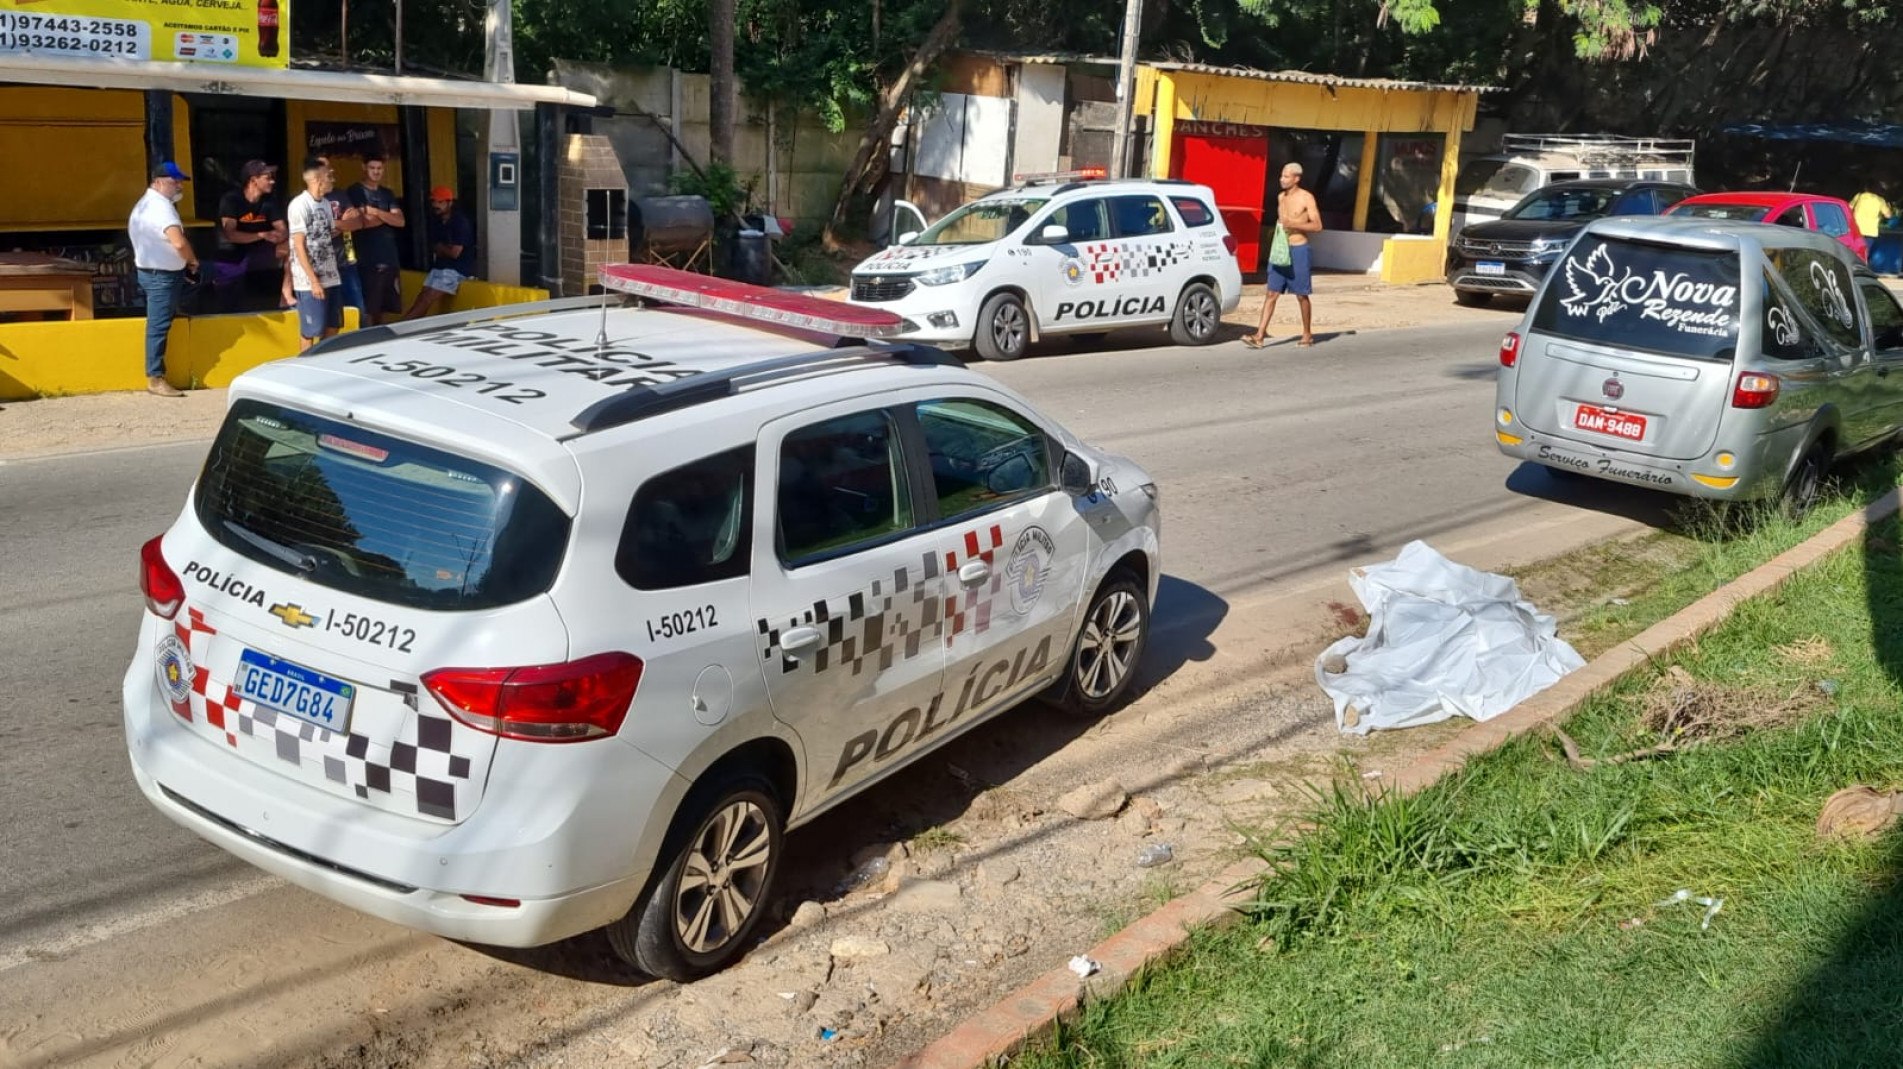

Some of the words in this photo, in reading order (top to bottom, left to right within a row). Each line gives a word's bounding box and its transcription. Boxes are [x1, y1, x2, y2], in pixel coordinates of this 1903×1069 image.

[1054, 294, 1166, 321] POLÍCIA
[1621, 270, 1736, 307] Nova
[1640, 298, 1730, 327] Rezende
[349, 353, 547, 404] I-50212
[1538, 446, 1590, 469] Serviço
[1597, 459, 1673, 484] Funerário
[183, 560, 266, 607] POLÍCIA
[325, 608, 416, 653] I-50212
[646, 604, 719, 642] I-50212
[244, 667, 334, 723] GED7G84
[825, 634, 1052, 792] POLÍCIA
